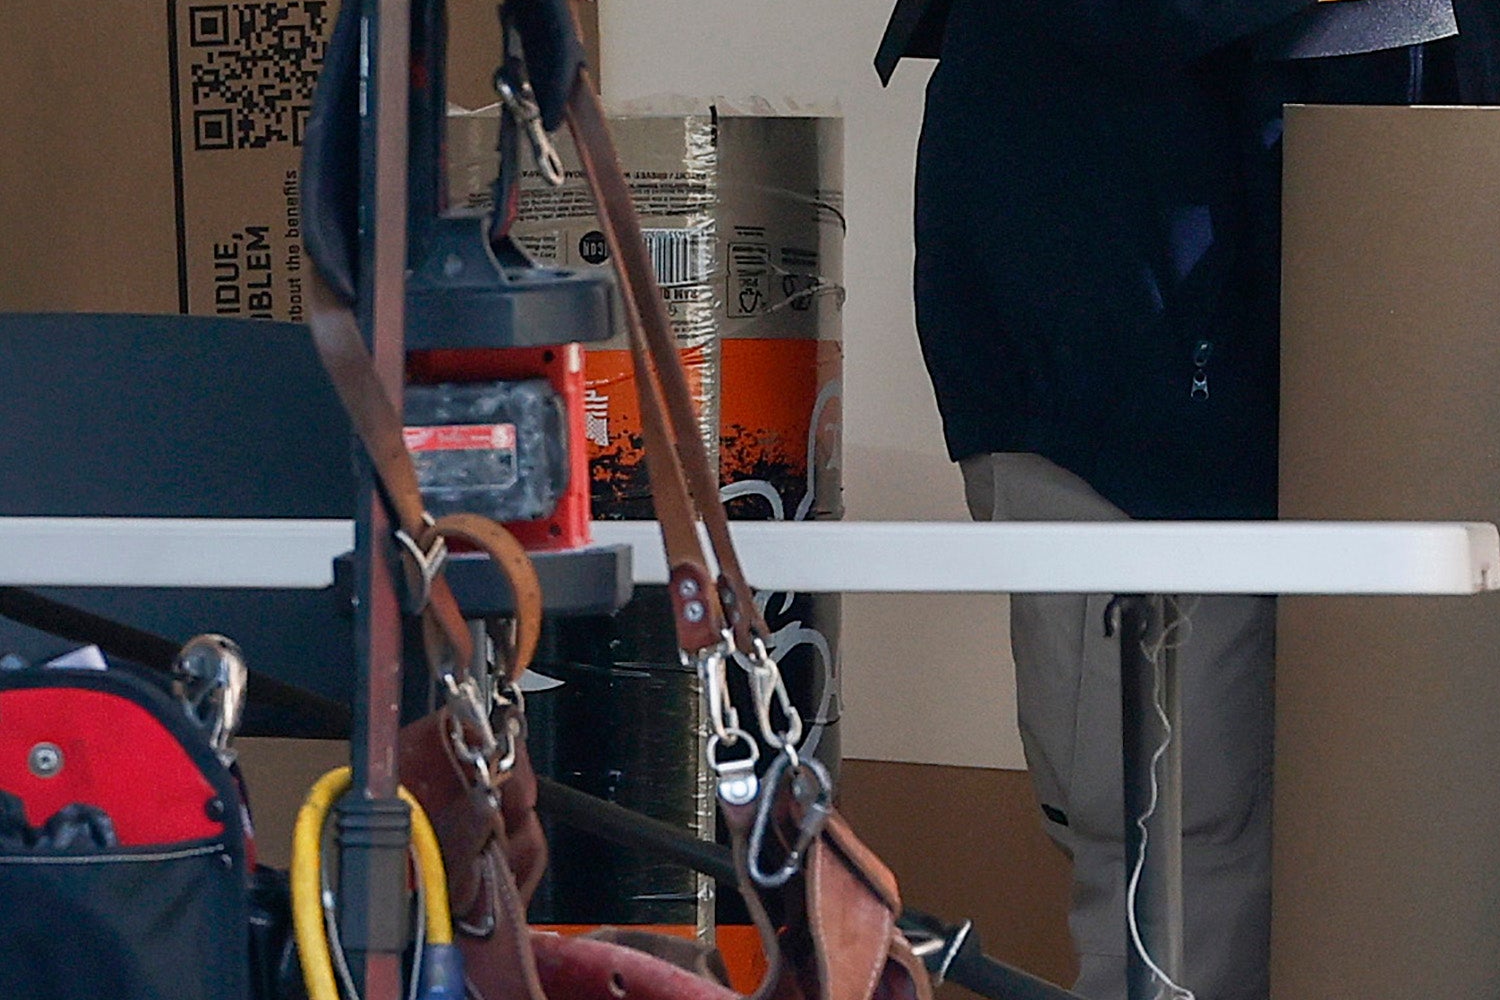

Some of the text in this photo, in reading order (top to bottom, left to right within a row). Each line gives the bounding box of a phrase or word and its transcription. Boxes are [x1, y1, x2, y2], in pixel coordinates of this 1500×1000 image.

[283, 169, 299, 238] benefits
[214, 232, 243, 314] IDUE,
[286, 245, 300, 271] the
